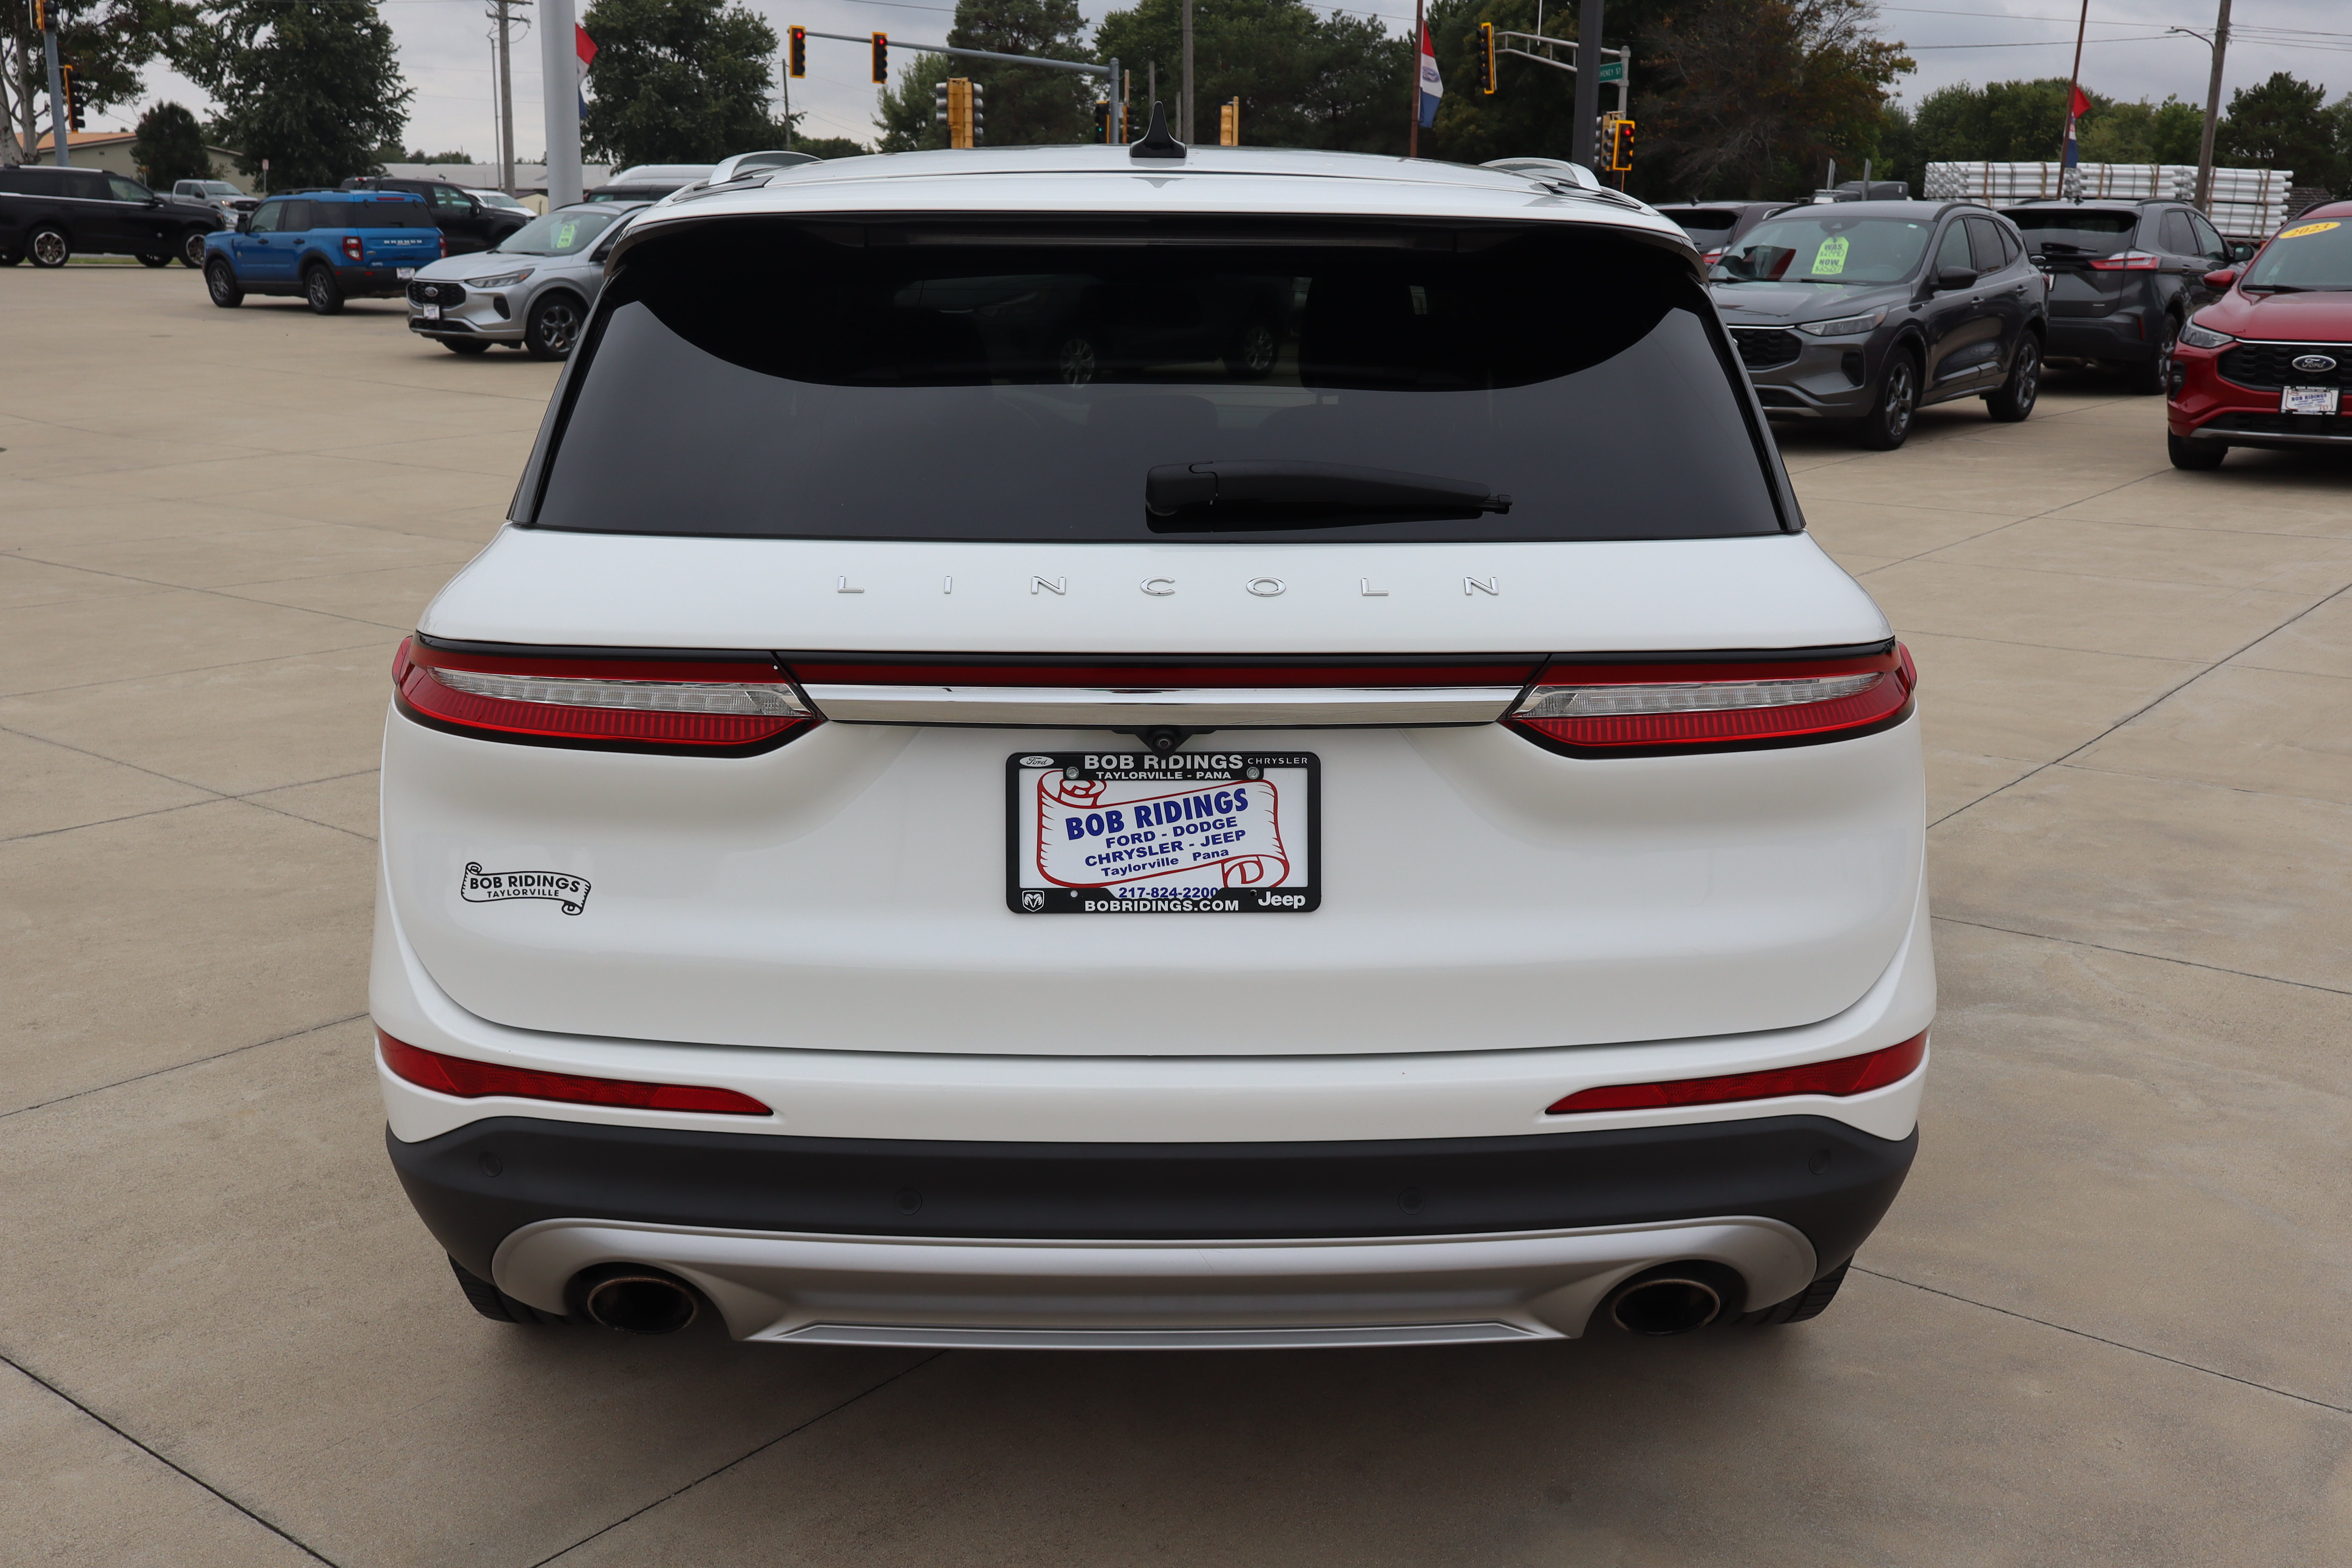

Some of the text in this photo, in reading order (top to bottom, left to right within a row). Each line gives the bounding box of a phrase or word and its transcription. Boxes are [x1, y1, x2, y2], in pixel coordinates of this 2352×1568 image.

[1599, 69, 1613, 77] HENEY
[2288, 223, 2330, 237] 2023
[2302, 358, 2326, 368] Ford
[837, 575, 1499, 596] LINCOLN
[1026, 757, 1047, 766] Ford
[1085, 755, 1243, 769] BOB RIDINGS
[1096, 771, 1183, 780] TAYLORVILLE
[1196, 771, 1232, 780] PANA
[1065, 788, 1248, 841] BOB RIDINGS
[1106, 831, 1156, 849] FORD
[1173, 816, 1238, 837] DODGE
[1085, 840, 1184, 866] CHRYSLER
[1200, 829, 1246, 847] JEEP
[1101, 849, 1229, 877] Taylorville Pana
[470, 875, 581, 893] BOB RIDINGS
[487, 889, 559, 898] TAYLORVILLE
[1118, 887, 1219, 898] 217-824-2200
[1085, 900, 1239, 911] BOBRIDINGS.COM
[1258, 891, 1306, 909] Jeep
